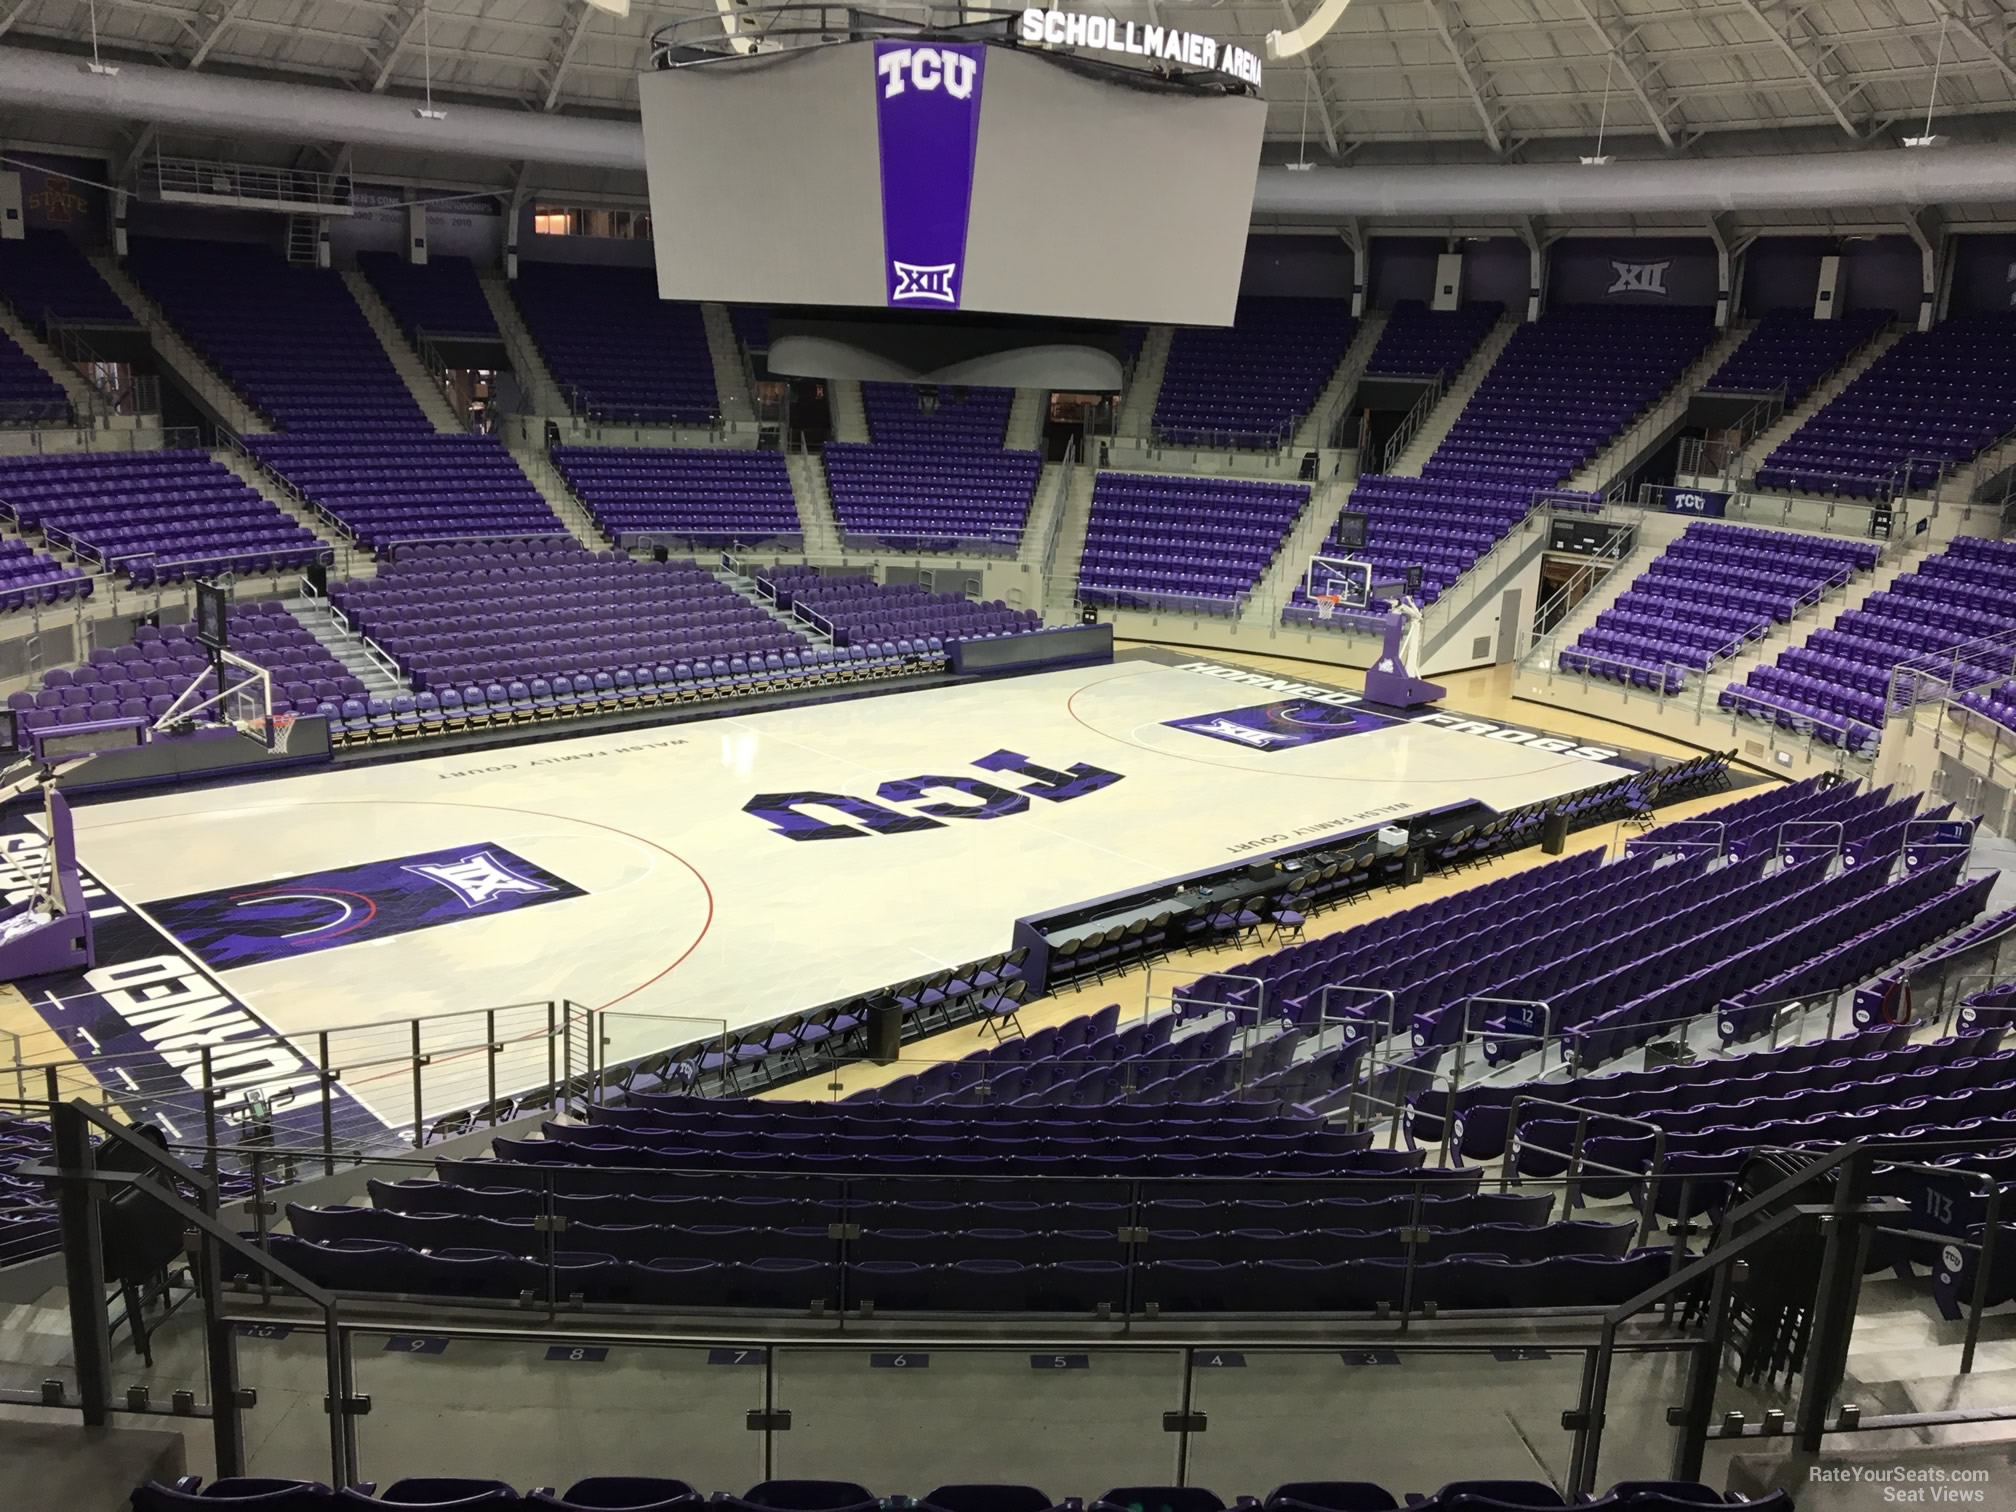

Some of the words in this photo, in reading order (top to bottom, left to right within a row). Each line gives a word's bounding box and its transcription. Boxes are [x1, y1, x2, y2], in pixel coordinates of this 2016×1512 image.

[1023, 8, 1218, 69] SCHOLLMAIER
[1218, 43, 1262, 88] ARENA
[878, 47, 977, 100] TCU
[1675, 494, 1706, 510] TCU
[1174, 662, 1363, 704] HORNED
[1408, 710, 1620, 761] FROGS
[615, 738, 690, 754] WALSH
[530, 751, 608, 767] FAMILY
[438, 764, 518, 780] COURT
[741, 748, 1127, 841] TCU
[1353, 802, 1415, 820] WALSH
[1292, 816, 1354, 837] FAMILY
[1226, 833, 1289, 854] COURT
[1522, 1008, 1534, 1024] 12
[1926, 1187, 1954, 1225] 113
[1945, 1250, 1961, 1267] TCU
[411, 1340, 425, 1352] 9
[569, 1348, 583, 1360] 8
[733, 1351, 748, 1364] 7
[893, 1355, 907, 1366] 6
[1054, 1357, 1067, 1368] 5
[1211, 1355, 1224, 1366] 4
[1367, 1354, 1378, 1364] 3
